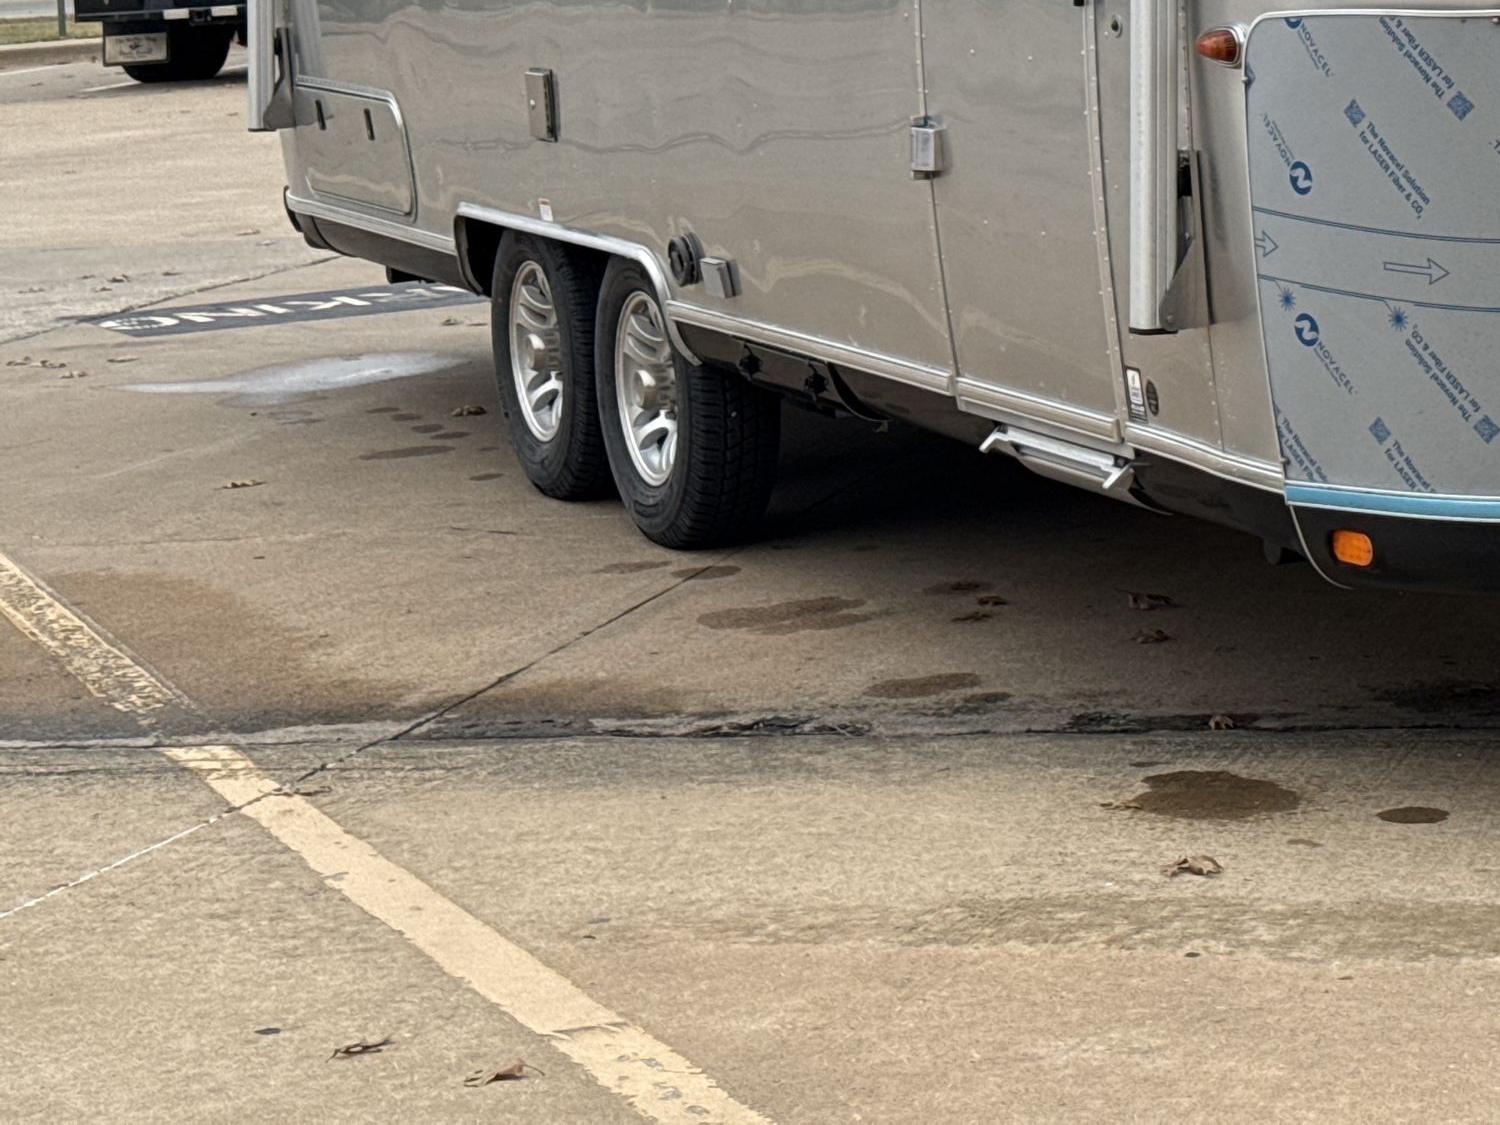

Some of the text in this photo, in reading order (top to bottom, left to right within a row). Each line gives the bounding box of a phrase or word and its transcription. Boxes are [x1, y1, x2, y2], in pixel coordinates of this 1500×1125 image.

[1300, 25, 1331, 77] NOVACEL
[1379, 15, 1444, 99] The Novacel Solution
[1401, 27, 1420, 50] Fiber
[1417, 47, 1443, 76] LASER
[1441, 74, 1454, 89] for
[1263, 112, 1291, 167] NOVACEL
[1358, 130, 1369, 144] for
[1368, 143, 1390, 172] LASER
[1387, 170, 1406, 193] Fiber
[1366, 121, 1429, 204] The Novacel Solution
[1317, 341, 1354, 395] NOVACEL
[1405, 338, 1471, 422] The Novacel Solution
[1428, 350, 1447, 373] Fiber
[1445, 371, 1470, 399] LASER
[1468, 398, 1480, 412] for
[1282, 417, 1293, 434] The
[1292, 434, 1316, 466] Novacel
[1390, 439, 1430, 489] The Novacel
[1384, 447, 1420, 489] for LASER
